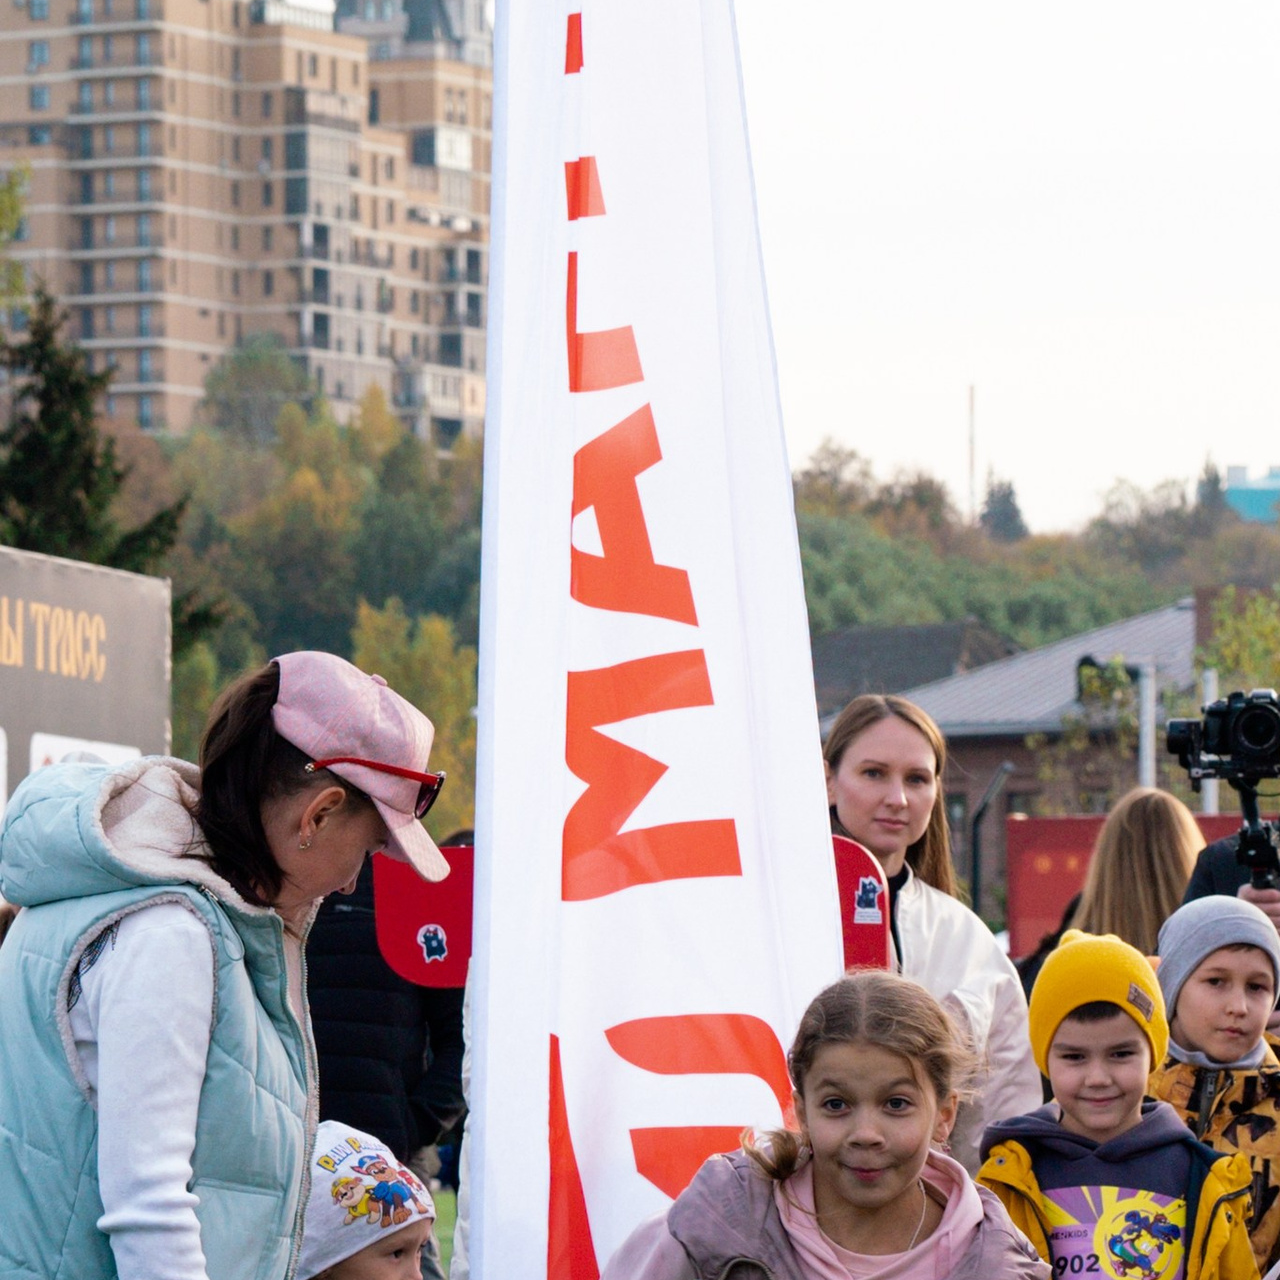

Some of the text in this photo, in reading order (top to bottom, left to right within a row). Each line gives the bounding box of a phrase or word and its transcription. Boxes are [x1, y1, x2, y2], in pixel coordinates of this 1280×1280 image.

[29, 601, 106, 682] ТРАСС
[316, 1144, 352, 1174] PAW
[1055, 1253, 1100, 1277] 902
